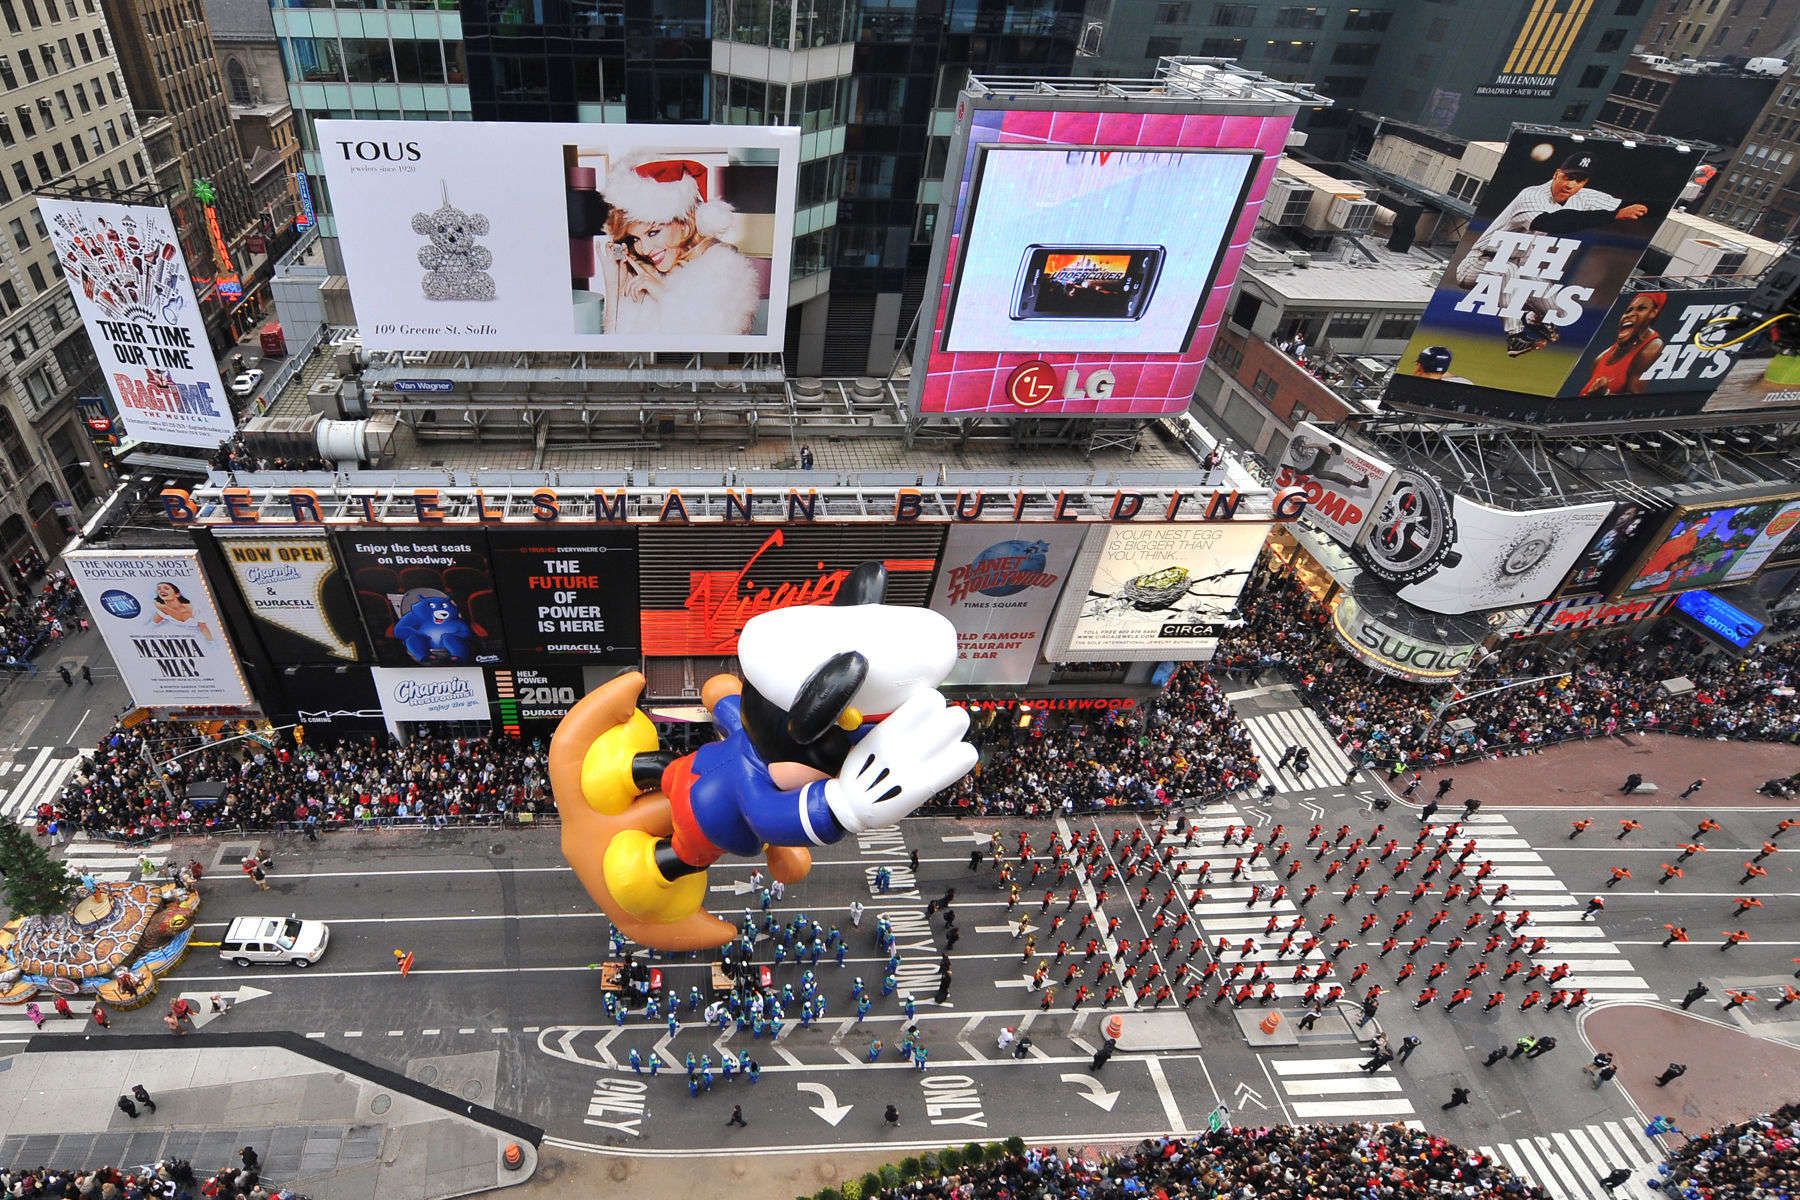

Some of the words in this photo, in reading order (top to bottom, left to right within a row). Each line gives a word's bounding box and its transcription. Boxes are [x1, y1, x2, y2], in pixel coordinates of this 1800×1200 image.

[1496, 75, 1557, 86] MILLENNIUM
[336, 141, 421, 161] TOUS
[350, 165, 377, 174] jewelers
[398, 165, 416, 173] 1920
[1484, 231, 1582, 281] TH
[1454, 274, 1595, 327] AT'S
[96, 320, 147, 344] THEIR
[147, 325, 195, 348] TIME
[375, 324, 396, 335] 109
[400, 325, 441, 335] Greene
[464, 325, 497, 336] SoHo
[113, 344, 147, 366] OUR
[147, 347, 193, 370] TIME
[399, 382, 416, 390] Van
[418, 382, 451, 392] Wagner
[1063, 369, 1116, 400] LG
[113, 373, 221, 417] RAGTIME
[166, 413, 209, 422] MUSICAL
[160, 488, 816, 522] BERTELSMANN
[894, 486, 1310, 521] BUILDING
[1115, 530, 1151, 540] YOUR
[1155, 530, 1191, 540] NEST
[1194, 530, 1223, 540] EGG
[355, 543, 388, 555] Enjoy
[391, 543, 410, 553] the
[412, 543, 438, 553] best
[441, 544, 472, 553] seats
[1108, 541, 1121, 550] IS
[1124, 541, 1174, 550] BIGGER
[1178, 541, 1213, 550] THAN
[231, 546, 273, 562] NOW
[277, 546, 325, 562] OPEN
[377, 556, 393, 565] on
[396, 555, 457, 566] Broadway.
[1107, 551, 1137, 560] YOU
[102, 560, 153, 569] WORLD'S
[157, 560, 190, 569] MOST
[543, 560, 580, 574] THE
[84, 569, 135, 578] POPULAR
[947, 556, 1028, 591] PLANET
[528, 576, 600, 590] FUTURE
[685, 528, 849, 651] Virgin
[947, 571, 1058, 606] HOLLYWOOD
[266, 587, 276, 596] &
[553, 591, 577, 604] OF
[254, 599, 314, 607] DURACELL
[538, 606, 601, 619] POWER
[538, 621, 555, 632] IS
[560, 620, 605, 632] HERE
[1163, 625, 1213, 634] CIRCA
[1704, 614, 1742, 641] EDITION
[957, 632, 978, 640] RLD
[982, 631, 1036, 640] FAMOUS
[132, 639, 206, 658] MAMMA
[547, 644, 602, 652] DURACELL
[957, 642, 1022, 650] STAURANT
[1357, 624, 1477, 669] swatc
[972, 651, 999, 659] BAR
[156, 659, 200, 677] MIA!
[393, 677, 469, 704] Charmin
[519, 687, 575, 705] 2010
[1022, 698, 1135, 710] HOLLYWOOD
[522, 709, 567, 717] DURACEL
[584, 1078, 648, 1136] ONLY
[920, 1075, 988, 1127] ONLY
